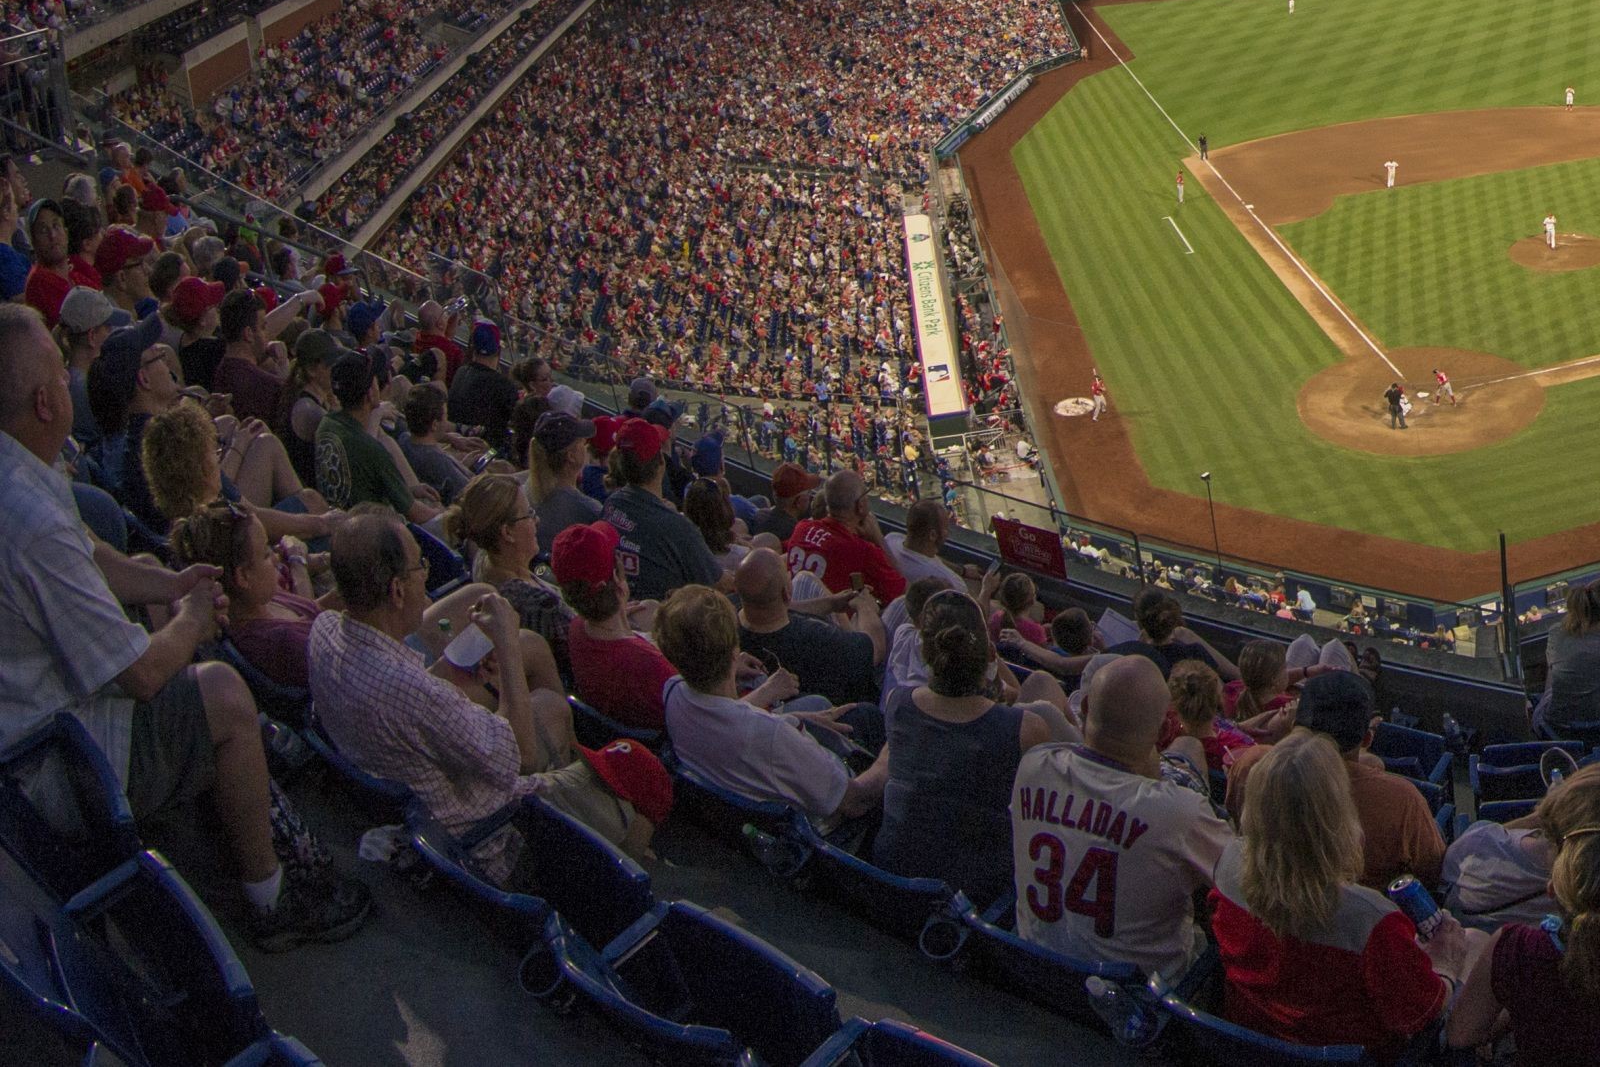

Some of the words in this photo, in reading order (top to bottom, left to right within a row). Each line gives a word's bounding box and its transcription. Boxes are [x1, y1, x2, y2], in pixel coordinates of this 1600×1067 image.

[918, 272, 933, 298] Citizens
[922, 298, 940, 318] Bank
[925, 318, 943, 337] Park
[805, 526, 832, 547] LEE
[1020, 787, 1148, 850] HALLADAY
[1025, 832, 1120, 938] 34
